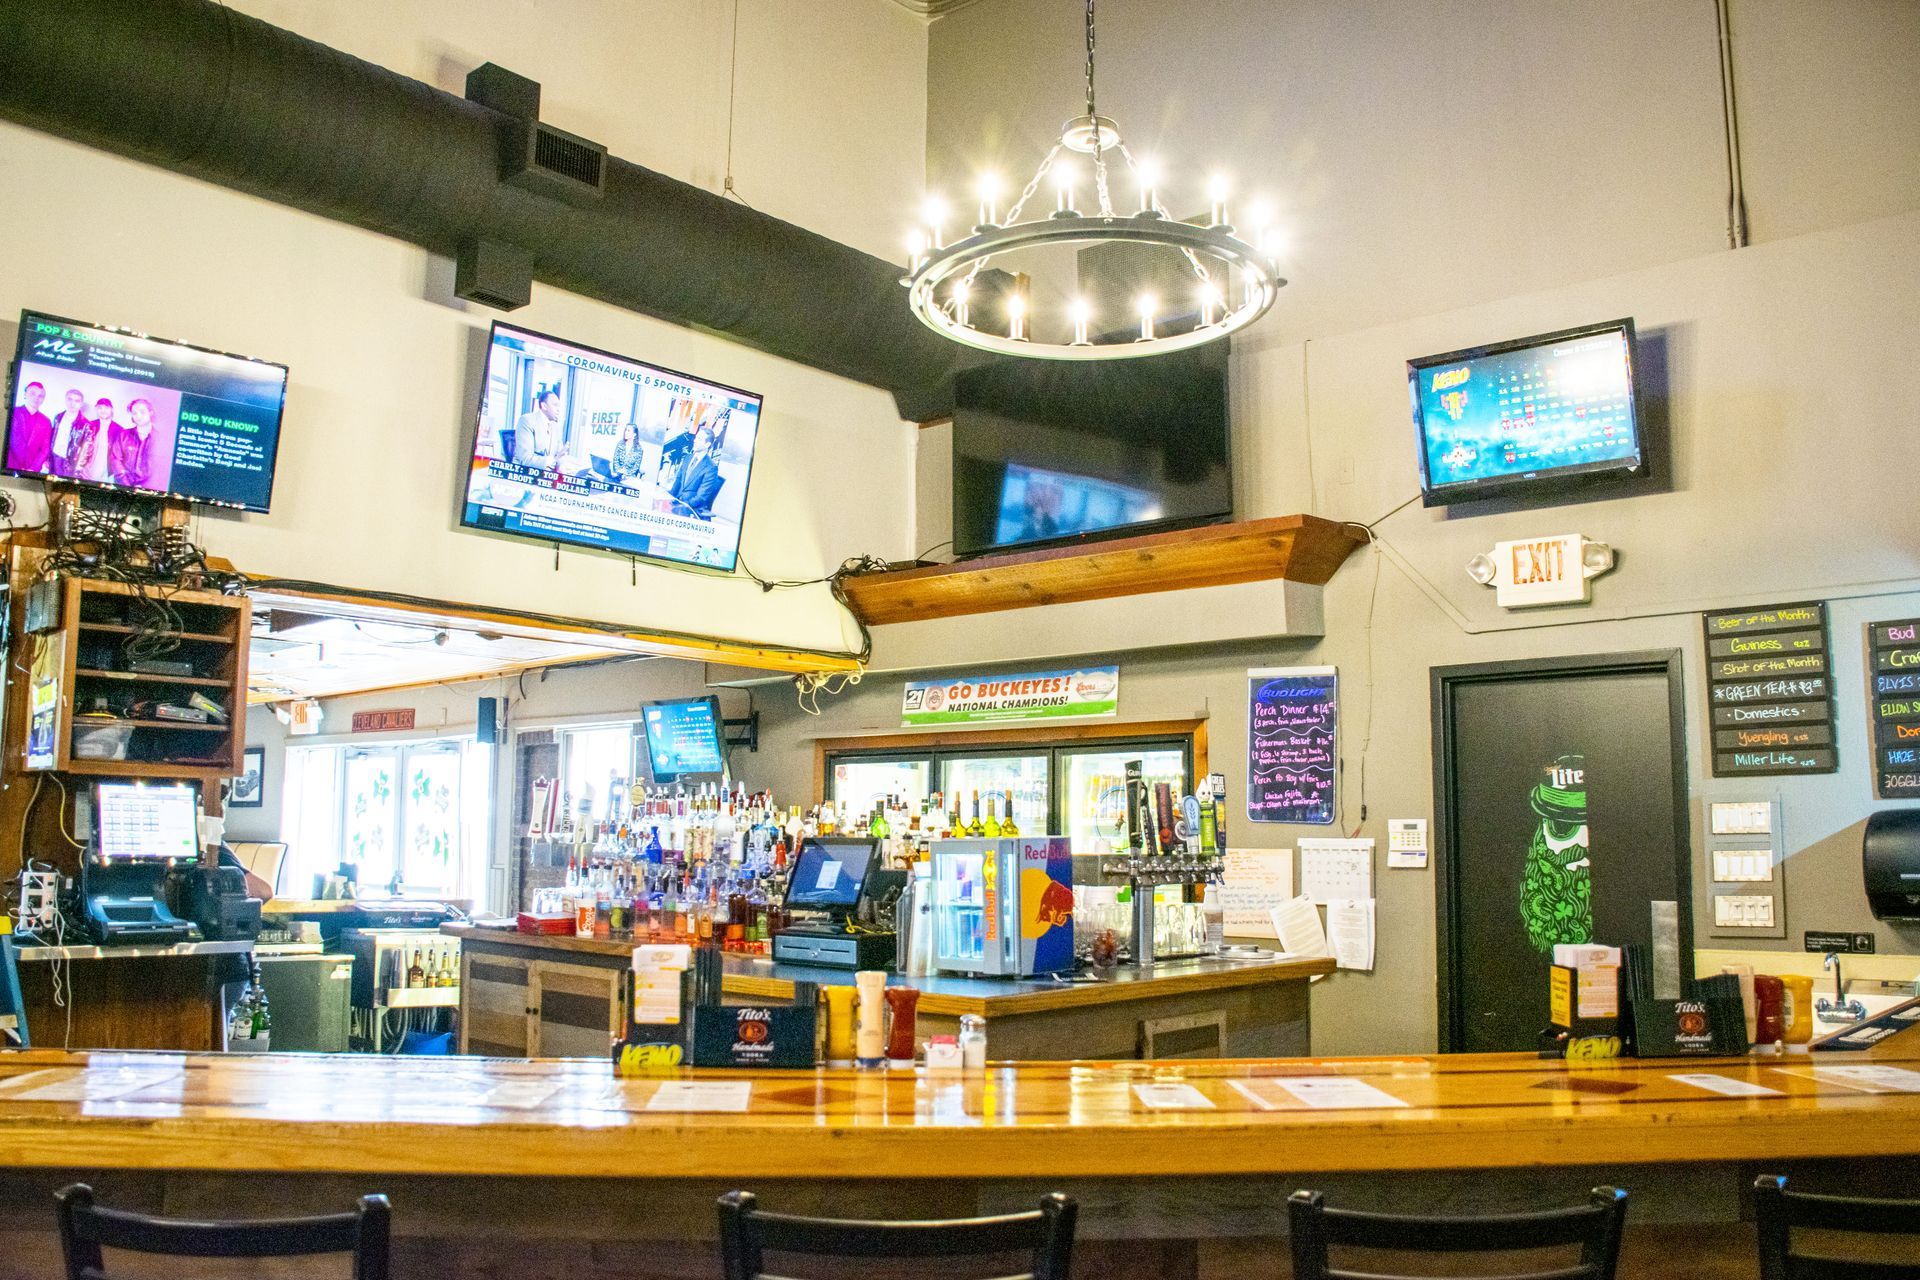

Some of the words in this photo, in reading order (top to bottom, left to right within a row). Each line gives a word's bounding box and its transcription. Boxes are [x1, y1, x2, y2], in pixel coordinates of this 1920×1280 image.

[36, 322, 61, 335] POP
[62, 329, 71, 338] &
[72, 331, 125, 349] COUNTRY
[567, 355, 642, 383] CORONAVIRUS
[644, 376, 651, 385] &
[653, 379, 692, 396] SPORTS
[181, 411, 199, 422] DID
[201, 415, 222, 427] YOU
[224, 419, 260, 433] KNOW?
[591, 411, 622, 424] FIRST
[590, 424, 617, 436] TAKE
[488, 460, 524, 474] CHARLY:
[528, 468, 539, 477] DO
[543, 470, 559, 480] YOU
[562, 475, 586, 487] THINK
[590, 481, 610, 491] THAT
[612, 485, 623, 494] IT
[625, 488, 640, 498] WAS
[488, 468, 504, 478] ALL
[507, 472, 534, 484] ABOUT
[537, 478, 552, 488] THE
[556, 482, 590, 496] DOLLARS
[539, 493, 557, 504] NCAA
[558, 496, 606, 513] TOURNAMENTS
[607, 506, 638, 520] CANCELED
[639, 512, 665, 525] BECAUSE
[666, 517, 675, 526] OF
[675, 519, 716, 535] CORONAVIRUS
[1512, 541, 1564, 585] EXIT
[1718, 617, 1742, 629] Beer
[1745, 615, 1759, 625] of
[1759, 613, 1776, 623] the
[1777, 610, 1811, 621] Month
[1887, 624, 1915, 640] Bud
[1722, 662, 1750, 675] Shot
[1753, 660, 1768, 672] of
[1767, 660, 1785, 670] the
[1786, 656, 1820, 668] Month
[1288, 687, 1326, 697] LIGHT
[1877, 676, 1913, 692] ELVIS
[948, 685, 972, 700] GO
[1725, 684, 1762, 701] GREEN
[948, 700, 998, 712] NATIONAL
[1001, 696, 1068, 709] CHAMPIONS!
[1255, 702, 1277, 716] Perch
[1280, 704, 1309, 716] Dinner
[1734, 707, 1800, 721] Domestics
[1738, 730, 1789, 747] Yuengling
[1734, 752, 1768, 767] Miller
[1770, 751, 1797, 765] Lite
[1888, 750, 1916, 764] HAZE
[1253, 774, 1272, 785] Perch
[1551, 768, 1584, 790] Lite
[1025, 845, 1048, 860] Red
[1049, 844, 1070, 860] Bull
[986, 891, 996, 916] Bull
[986, 917, 996, 941] Red
[736, 1008, 772, 1021] Tito's
[1675, 1002, 1706, 1013] Tito's
[1675, 1032, 1712, 1042] Handmade
[732, 1040, 774, 1051] Handmade
[1566, 1036, 1621, 1059] KENO
[620, 1044, 684, 1066] KENO
